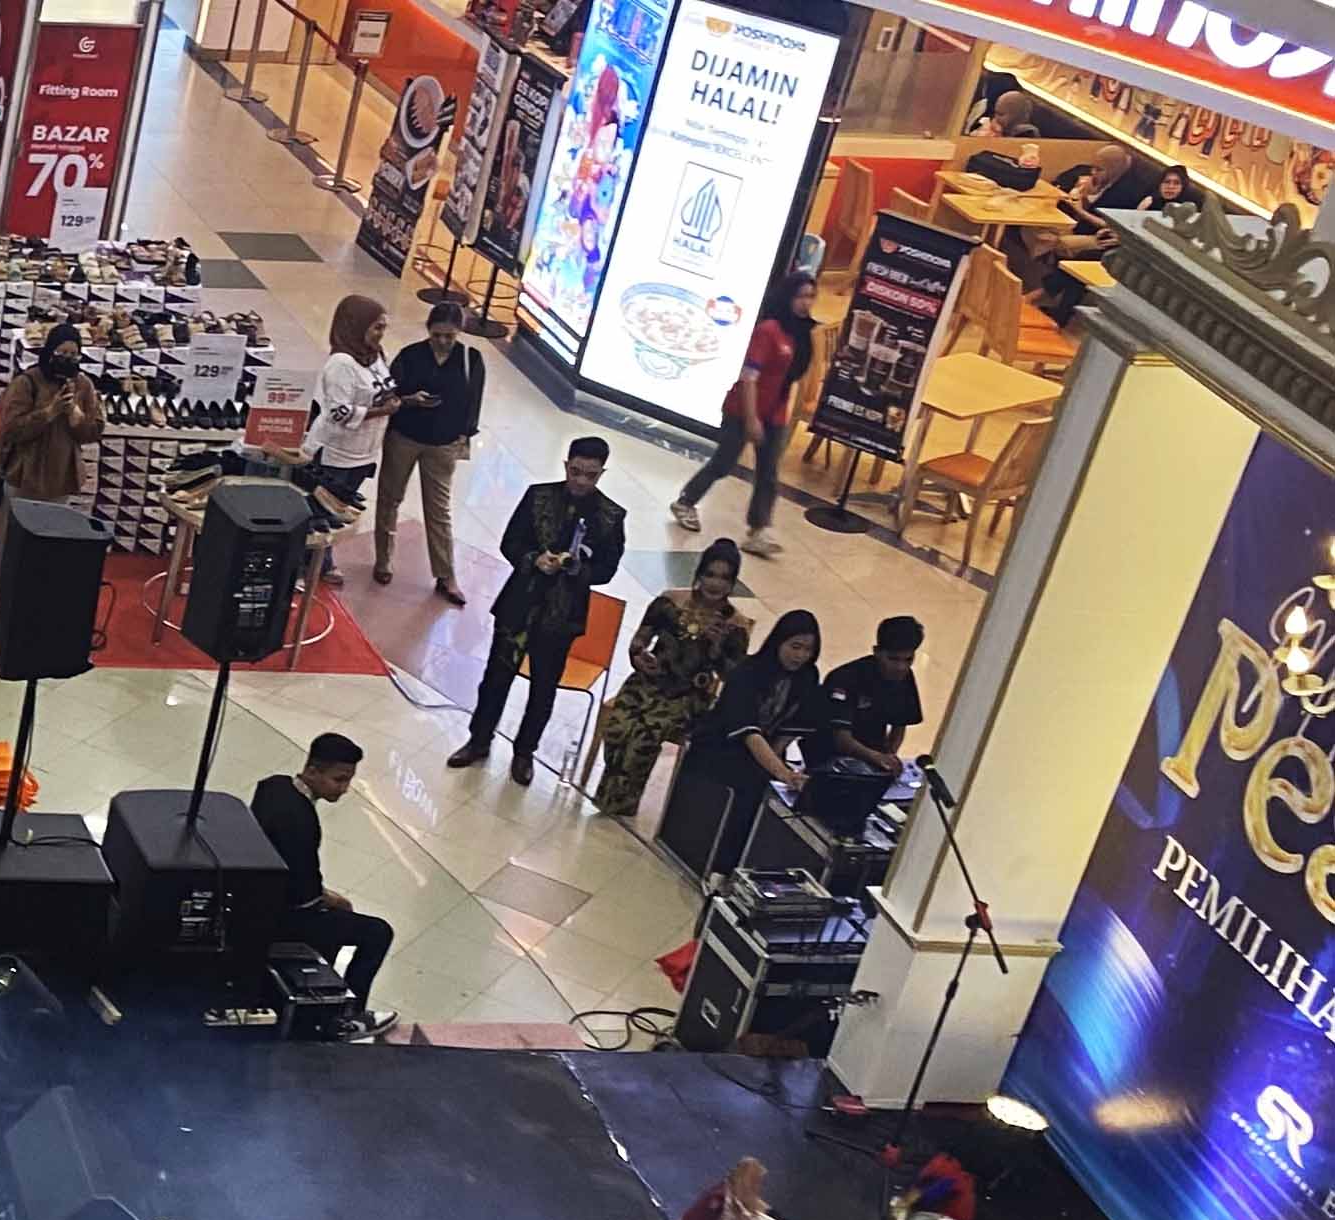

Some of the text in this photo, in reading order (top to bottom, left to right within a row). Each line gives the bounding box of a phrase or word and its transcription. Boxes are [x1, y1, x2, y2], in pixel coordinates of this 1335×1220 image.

[691, 50, 799, 98] DIJAMIN
[39, 84, 119, 100] Fitting Room
[690, 80, 782, 125] HALAL!
[32, 125, 110, 143] BAZAR
[25, 153, 105, 197] 70%
[61, 215, 84, 227] 129
[192, 364, 220, 378] 129
